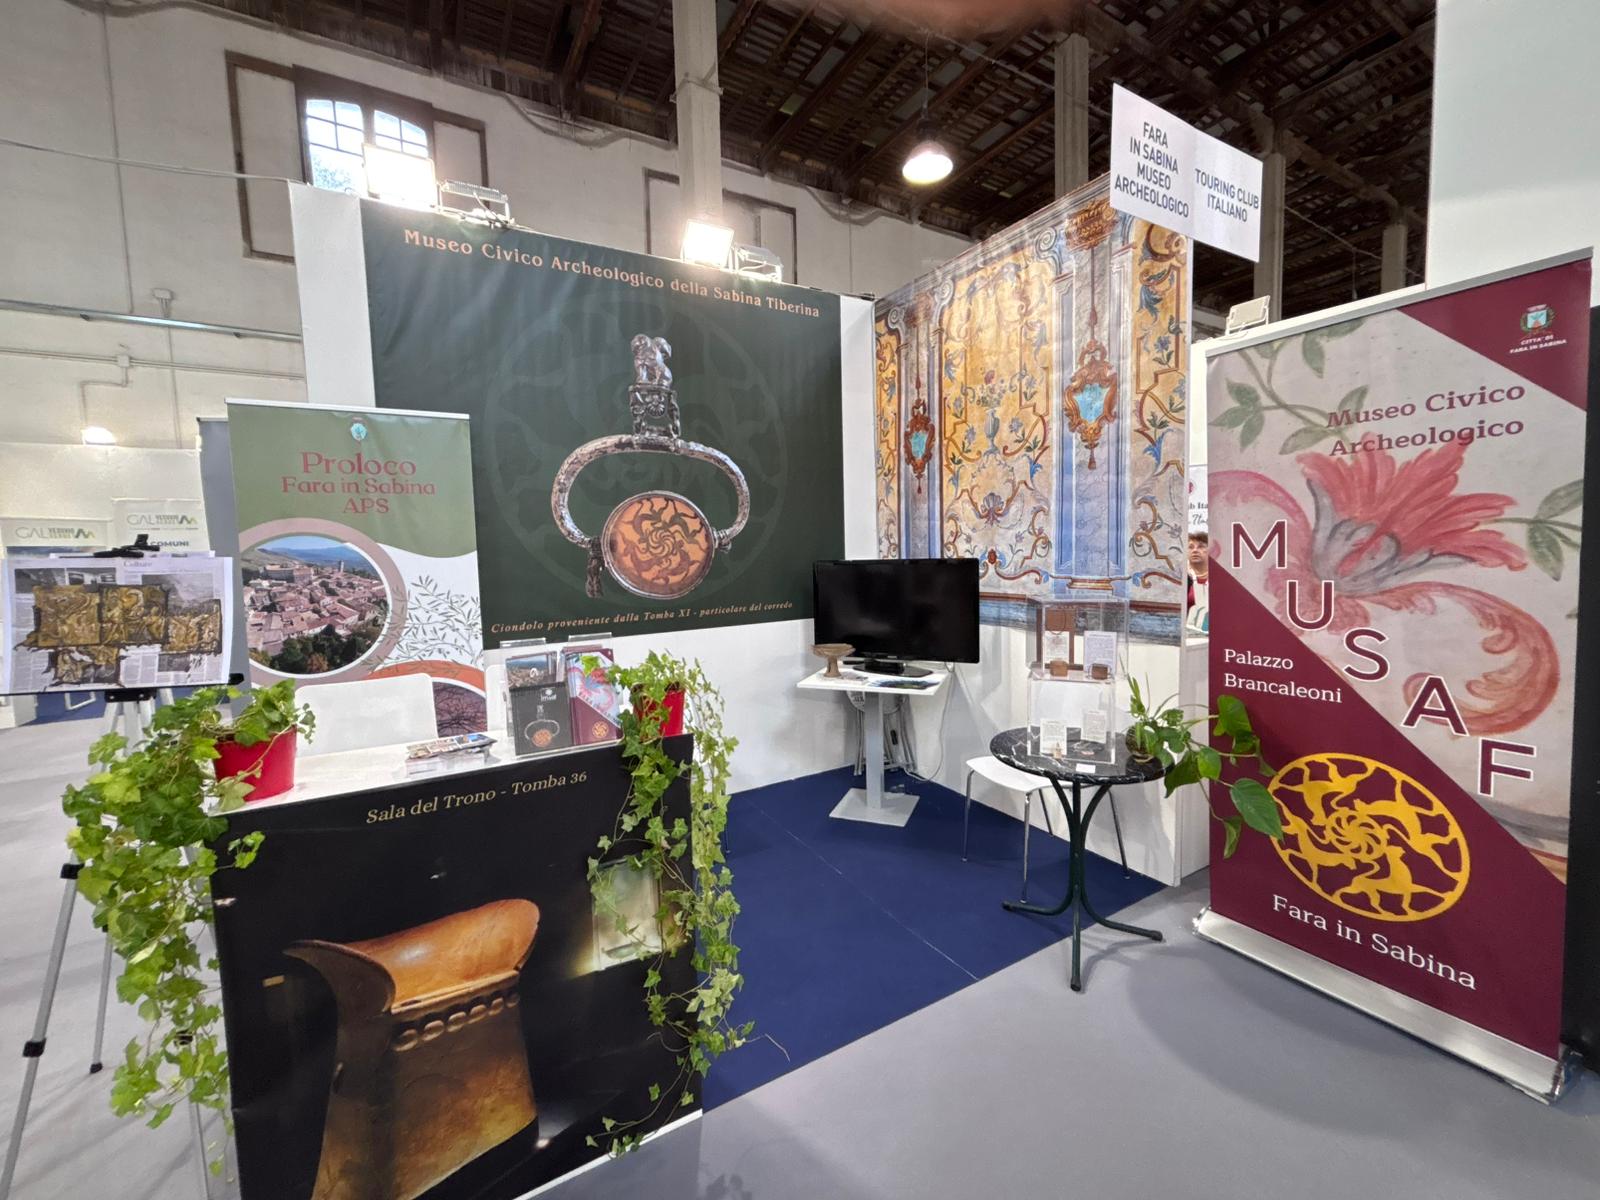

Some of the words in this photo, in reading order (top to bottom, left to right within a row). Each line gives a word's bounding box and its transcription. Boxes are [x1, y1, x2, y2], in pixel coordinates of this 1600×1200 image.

[1143, 122, 1168, 148] FARA
[1130, 137, 1141, 156] IN
[1143, 145, 1179, 174] SABINA
[1137, 162, 1171, 191] MUSEO
[1195, 168, 1236, 199] TOURING
[1237, 187, 1259, 209] CLUB
[1115, 174, 1189, 218] ARCHEOLOGICO
[1207, 193, 1248, 223] ITALIANO
[404, 229, 473, 255] Museo
[482, 243, 543, 268] Civico
[551, 257, 664, 288] Archeologico
[670, 278, 709, 297] della
[714, 286, 761, 307] Sabina
[766, 296, 820, 318] Tiberina
[1326, 403, 1416, 429] Museo
[1425, 385, 1525, 412] Civico
[1329, 420, 1524, 457] Archeologico
[301, 451, 416, 476] Proloco
[282, 476, 335, 494] Fara
[341, 478, 360, 494] in
[364, 478, 436, 495] Sabina
[343, 498, 390, 514] APS
[491, 620, 544, 633] Ciondolo
[548, 615, 610, 631] proveniente
[613, 613, 639, 622] dalla
[644, 609, 675, 620] Tomba
[678, 608, 691, 617] XI
[700, 605, 747, 618] particolare
[749, 603, 762, 611] del
[764, 601, 793, 610] corredo
[1224, 648, 1294, 670] Palazzo
[1224, 673, 1342, 703] Brancaleoni
[366, 805, 406, 824] Sala
[410, 796, 438, 815] del
[443, 788, 496, 809] Trono
[511, 775, 566, 796] Tomba
[570, 771, 587, 785] 36
[1273, 894, 1328, 931] Fara
[1336, 920, 1362, 945] in
[1371, 933, 1476, 991] Sabina
